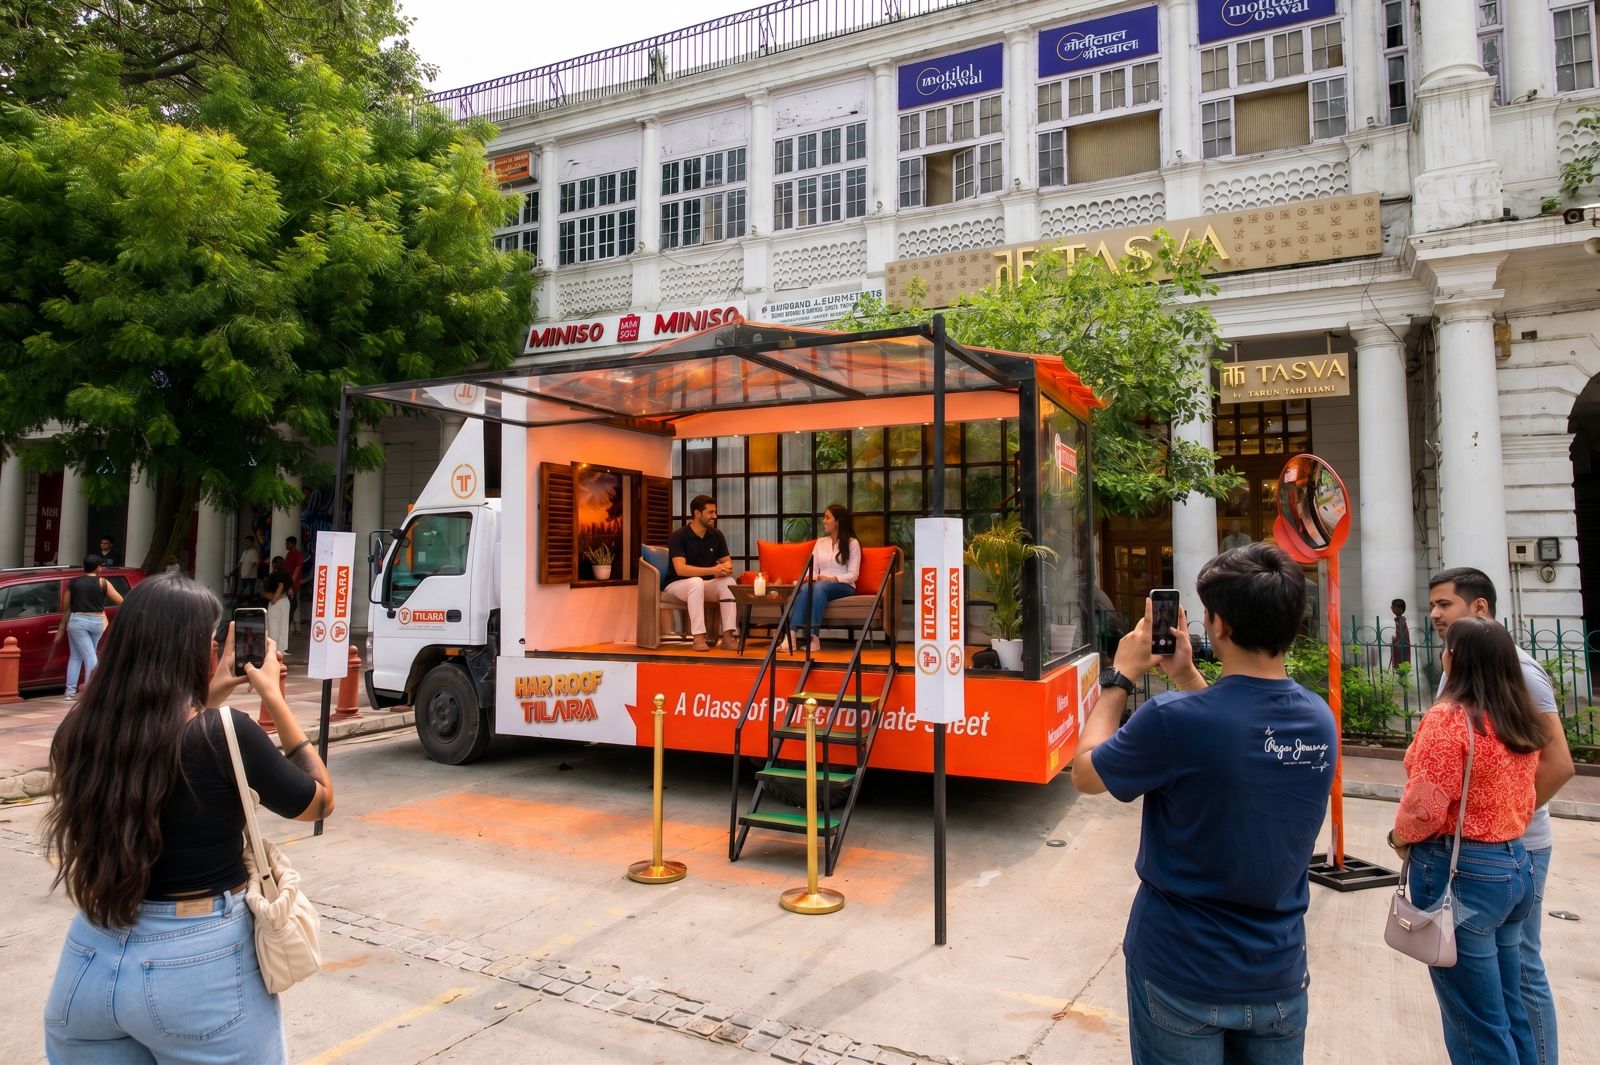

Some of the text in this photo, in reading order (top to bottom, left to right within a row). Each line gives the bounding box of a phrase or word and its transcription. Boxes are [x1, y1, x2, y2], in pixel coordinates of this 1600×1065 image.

[1254, 0, 1310, 21] oswal
[941, 70, 983, 91] oswal
[653, 306, 740, 335] MINISO
[529, 322, 604, 348] MINISO
[1256, 359, 1346, 383] TASVA
[1248, 389, 1280, 398] TARUN
[1284, 384, 1335, 395] TAHILIANI
[336, 569, 348, 616] TILARA
[924, 570, 935, 637] TILARA
[414, 612, 444, 621] TILARA
[515, 671, 603, 698] HAR ROOF
[520, 698, 599, 723] TILARA
[674, 692, 686, 716] A
[693, 693, 741, 719] Class
[747, 697, 768, 721] of
